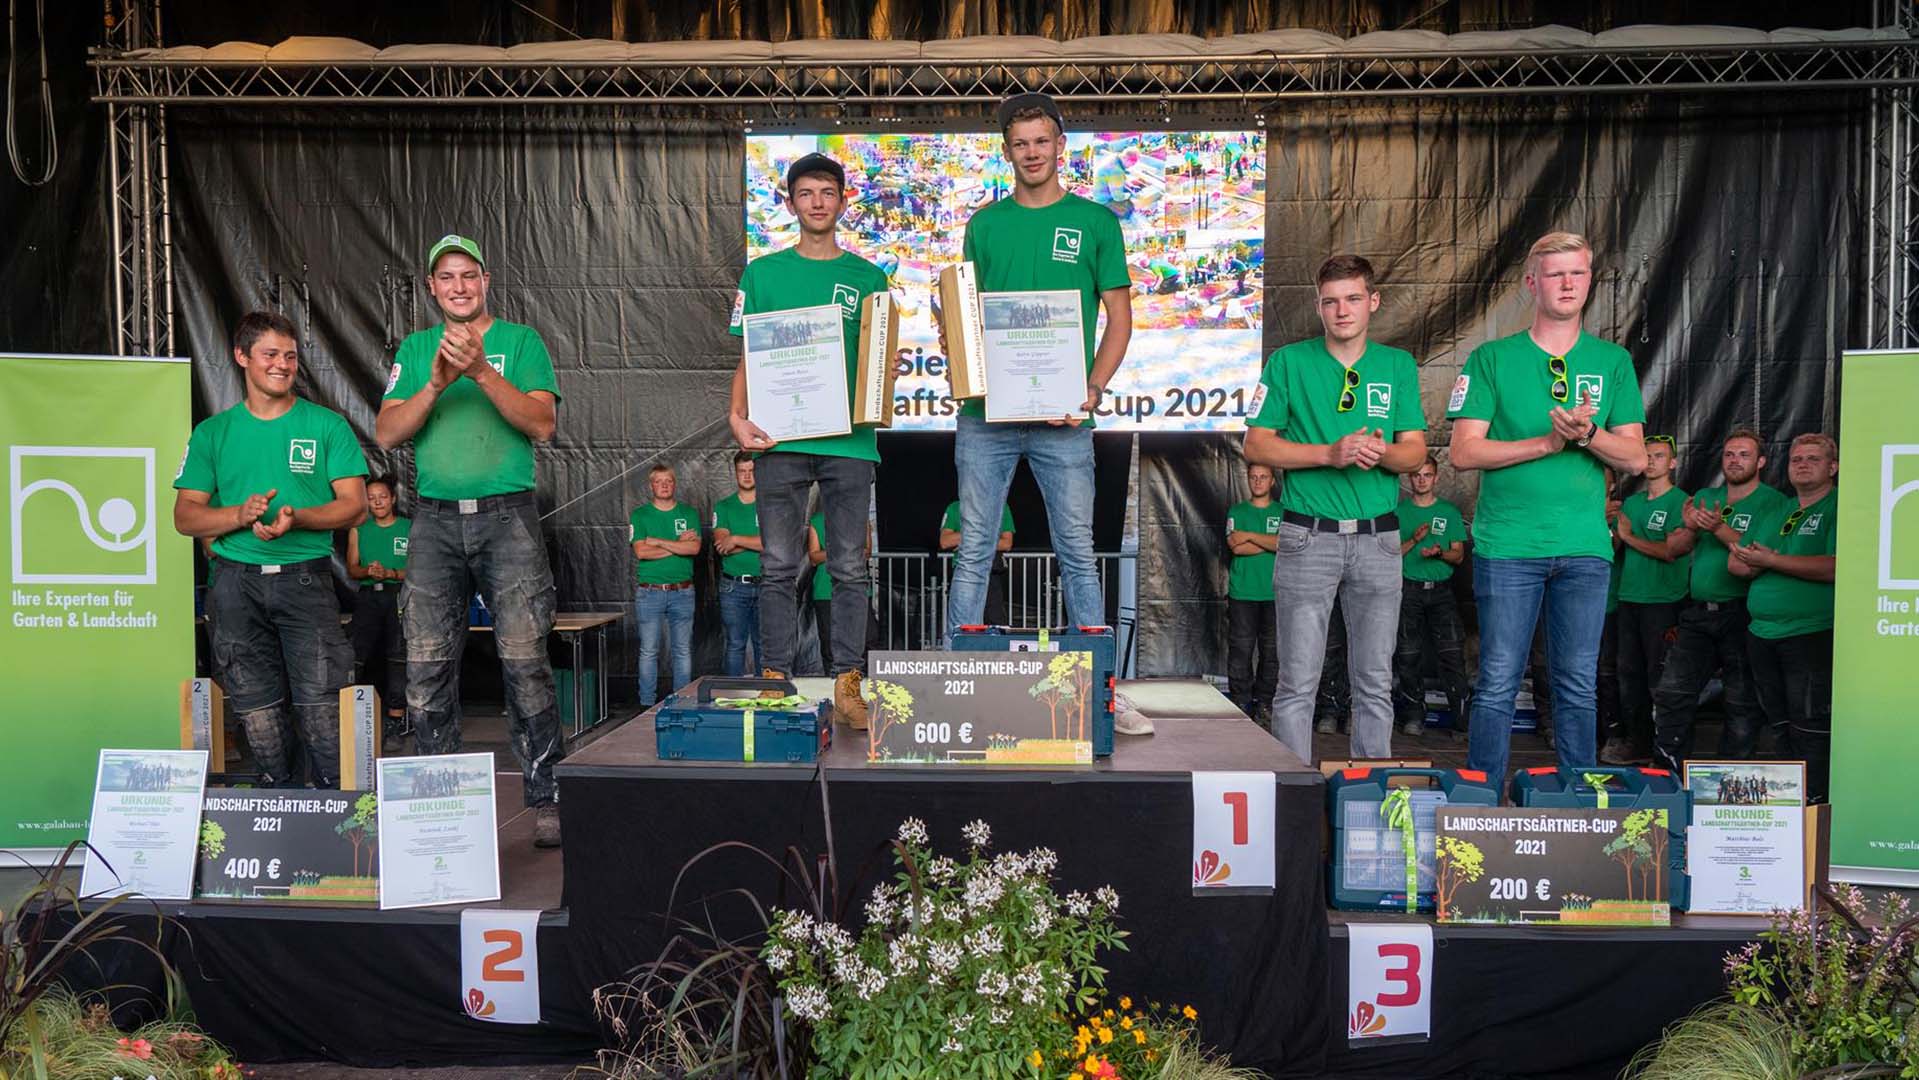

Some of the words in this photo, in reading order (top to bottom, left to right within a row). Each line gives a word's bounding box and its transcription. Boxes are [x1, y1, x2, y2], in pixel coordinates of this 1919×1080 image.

[958, 266, 965, 279] 1
[875, 295, 881, 308] 1
[897, 347, 949, 376] Sie
[1094, 388, 1156, 423] Cup
[1164, 387, 1248, 417] 2021
[12, 590, 41, 606] Ihre
[46, 590, 109, 610] Experten
[114, 590, 134, 606] für
[1877, 595, 1910, 613] Ihre
[13, 612, 63, 628] Garten
[67, 612, 79, 628] &
[83, 611, 158, 628] Landschaft
[876, 659, 1043, 675] LANDSCHAFTSGÄRTNER-CUP
[194, 682, 202, 693] 2
[356, 689, 365, 700] 2
[944, 680, 975, 695] 2021
[914, 722, 951, 744] 600
[958, 722, 973, 744] €
[1223, 792, 1248, 845] 1
[1715, 809, 1774, 820] URKUNDE
[253, 817, 282, 832] 2021
[1444, 815, 1617, 833] LANDSCHAFTSGÄRTNER-CUP
[1515, 839, 1546, 855] 2021
[224, 858, 260, 879] 400
[266, 858, 281, 879] €
[1490, 878, 1527, 900] 200
[1536, 878, 1551, 900] €
[482, 929, 524, 982] 2
[1376, 943, 1421, 1007] 3
